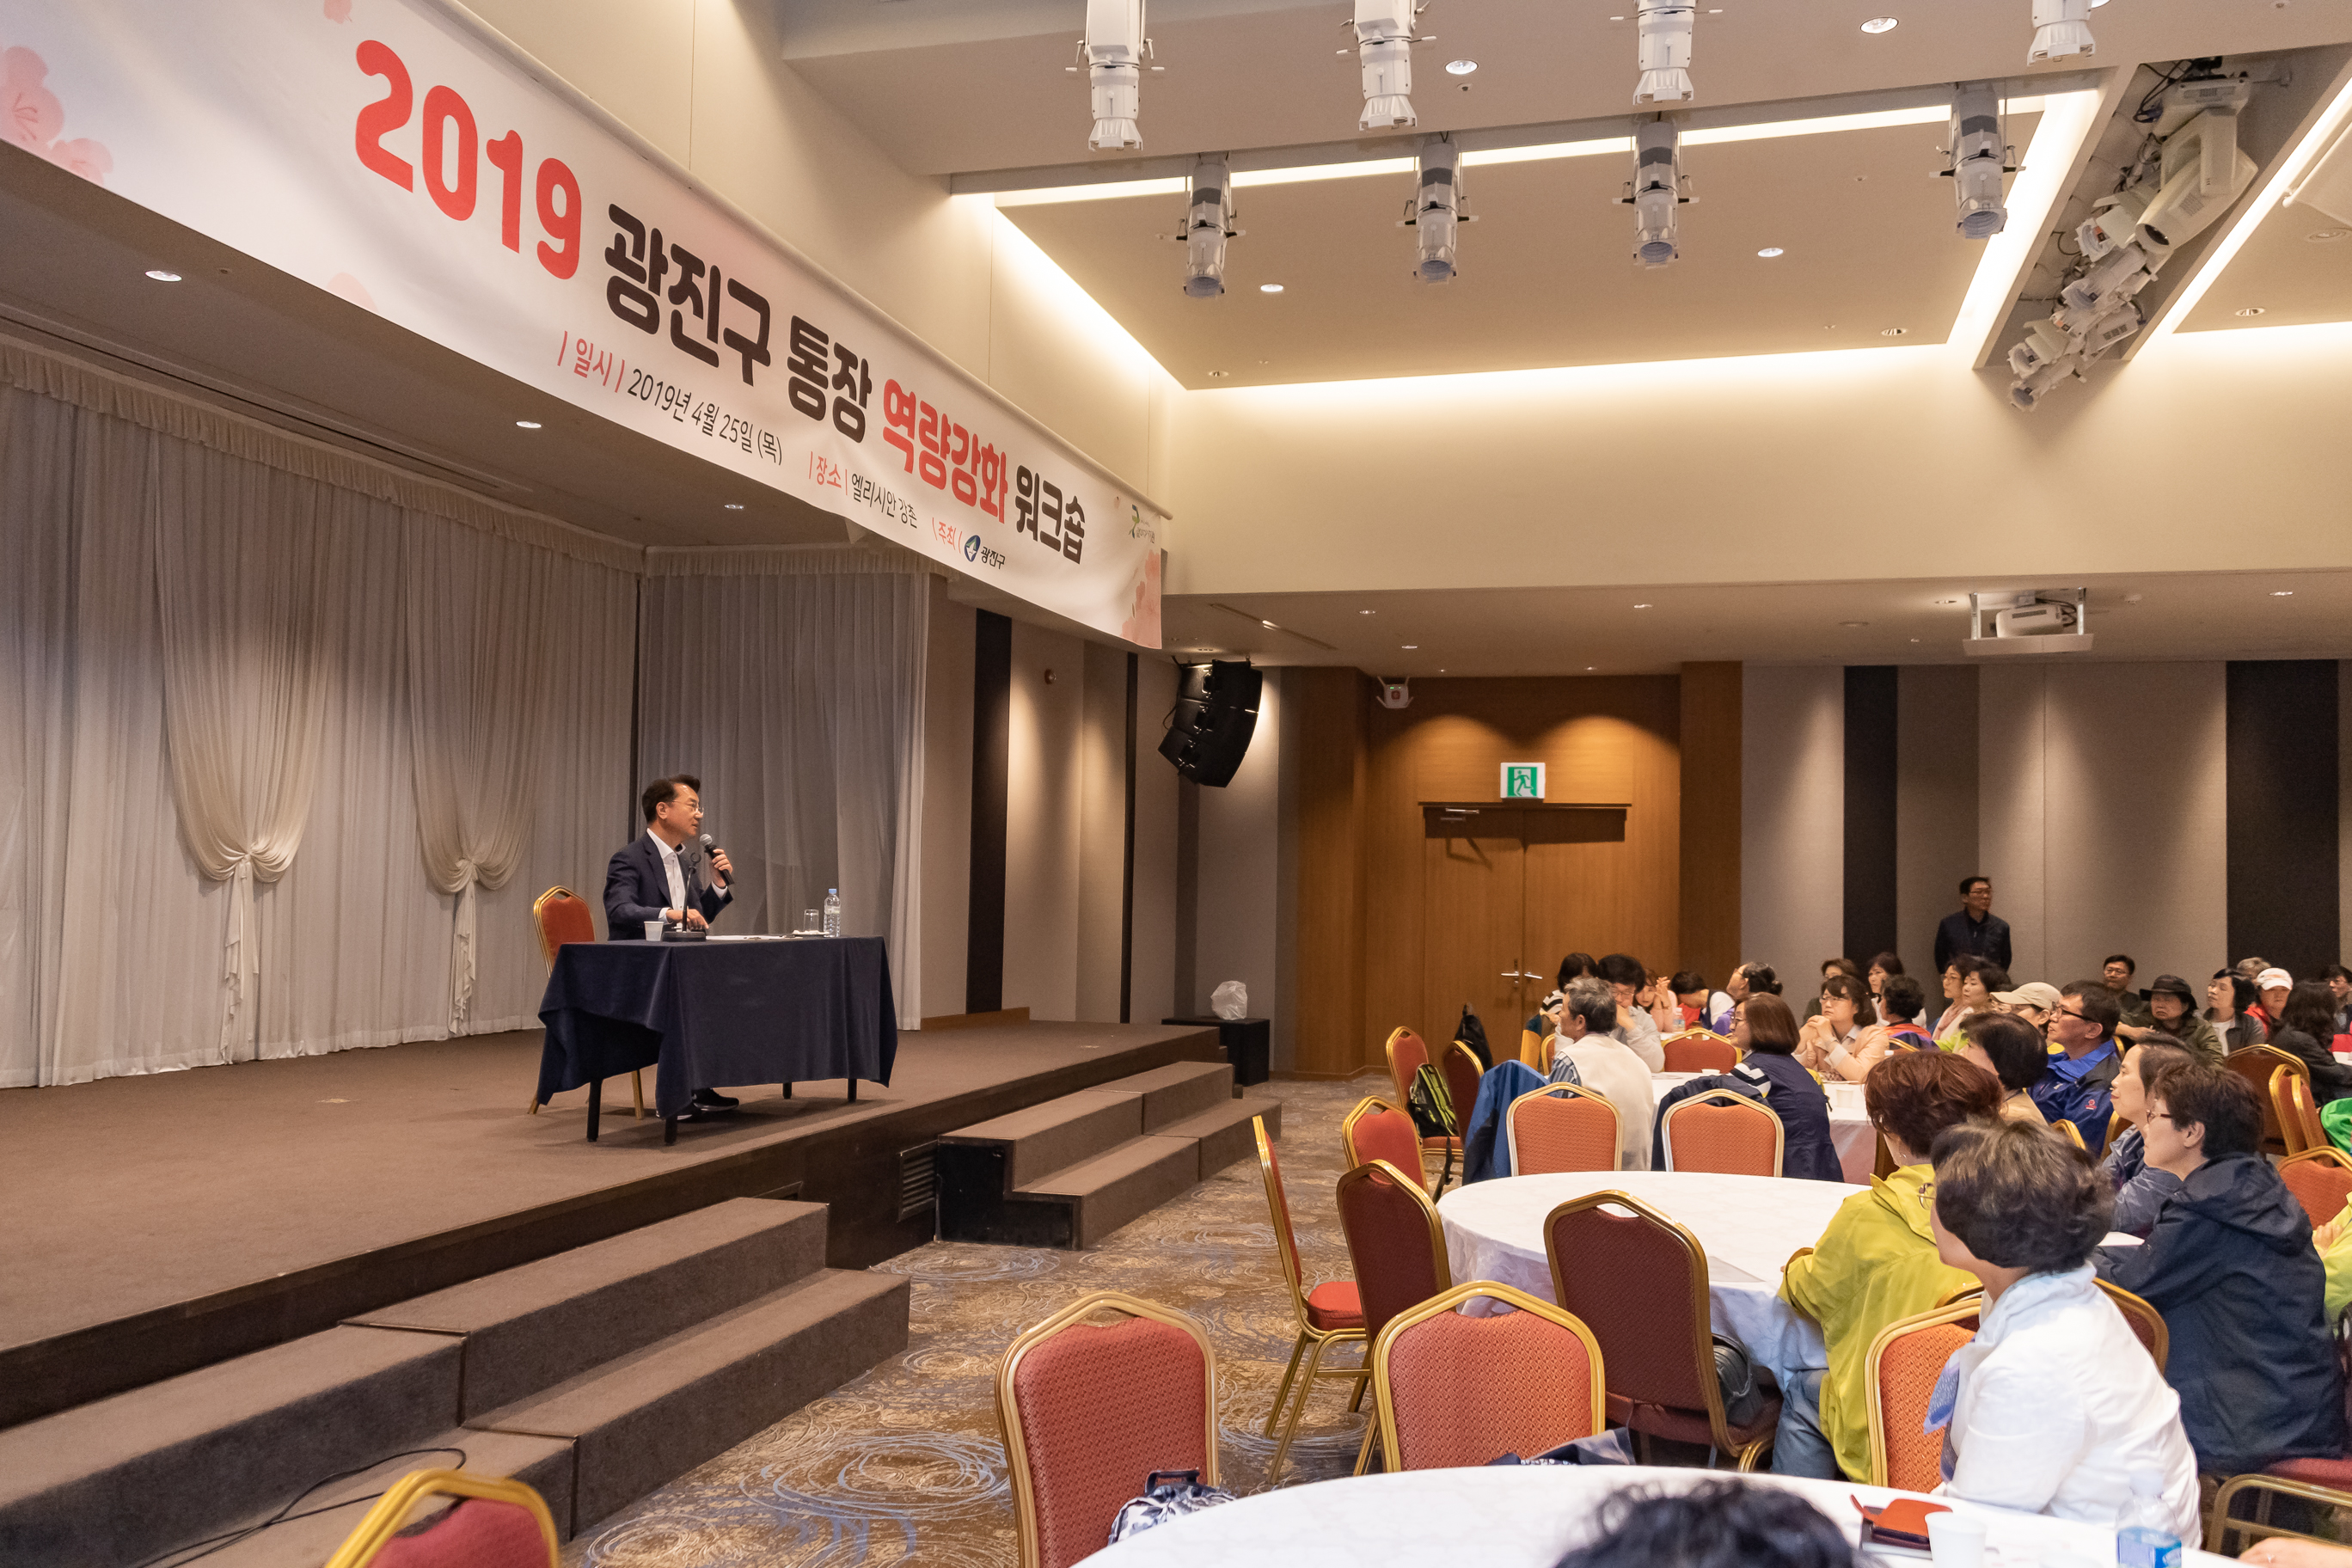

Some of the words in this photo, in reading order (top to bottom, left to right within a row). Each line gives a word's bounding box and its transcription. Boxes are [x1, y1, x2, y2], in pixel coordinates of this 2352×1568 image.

[355, 40, 582, 280] 2019
[604, 203, 771, 387] 광진구
[787, 315, 873, 444] 통장
[883, 378, 1008, 524] 역량강화
[1014, 464, 1086, 565] 워크숍
[573, 338, 613, 387] 일시
[627, 368, 692, 423] 2019년
[691, 401, 720, 437] 4월
[719, 413, 754, 454] 25일
[757, 428, 782, 466] (목)
[816, 455, 842, 489] 장소
[851, 473, 897, 518] 엘리시안
[897, 497, 918, 530] 강촌
[937, 520, 956, 551] 주최
[980, 545, 1006, 570] 광진구
